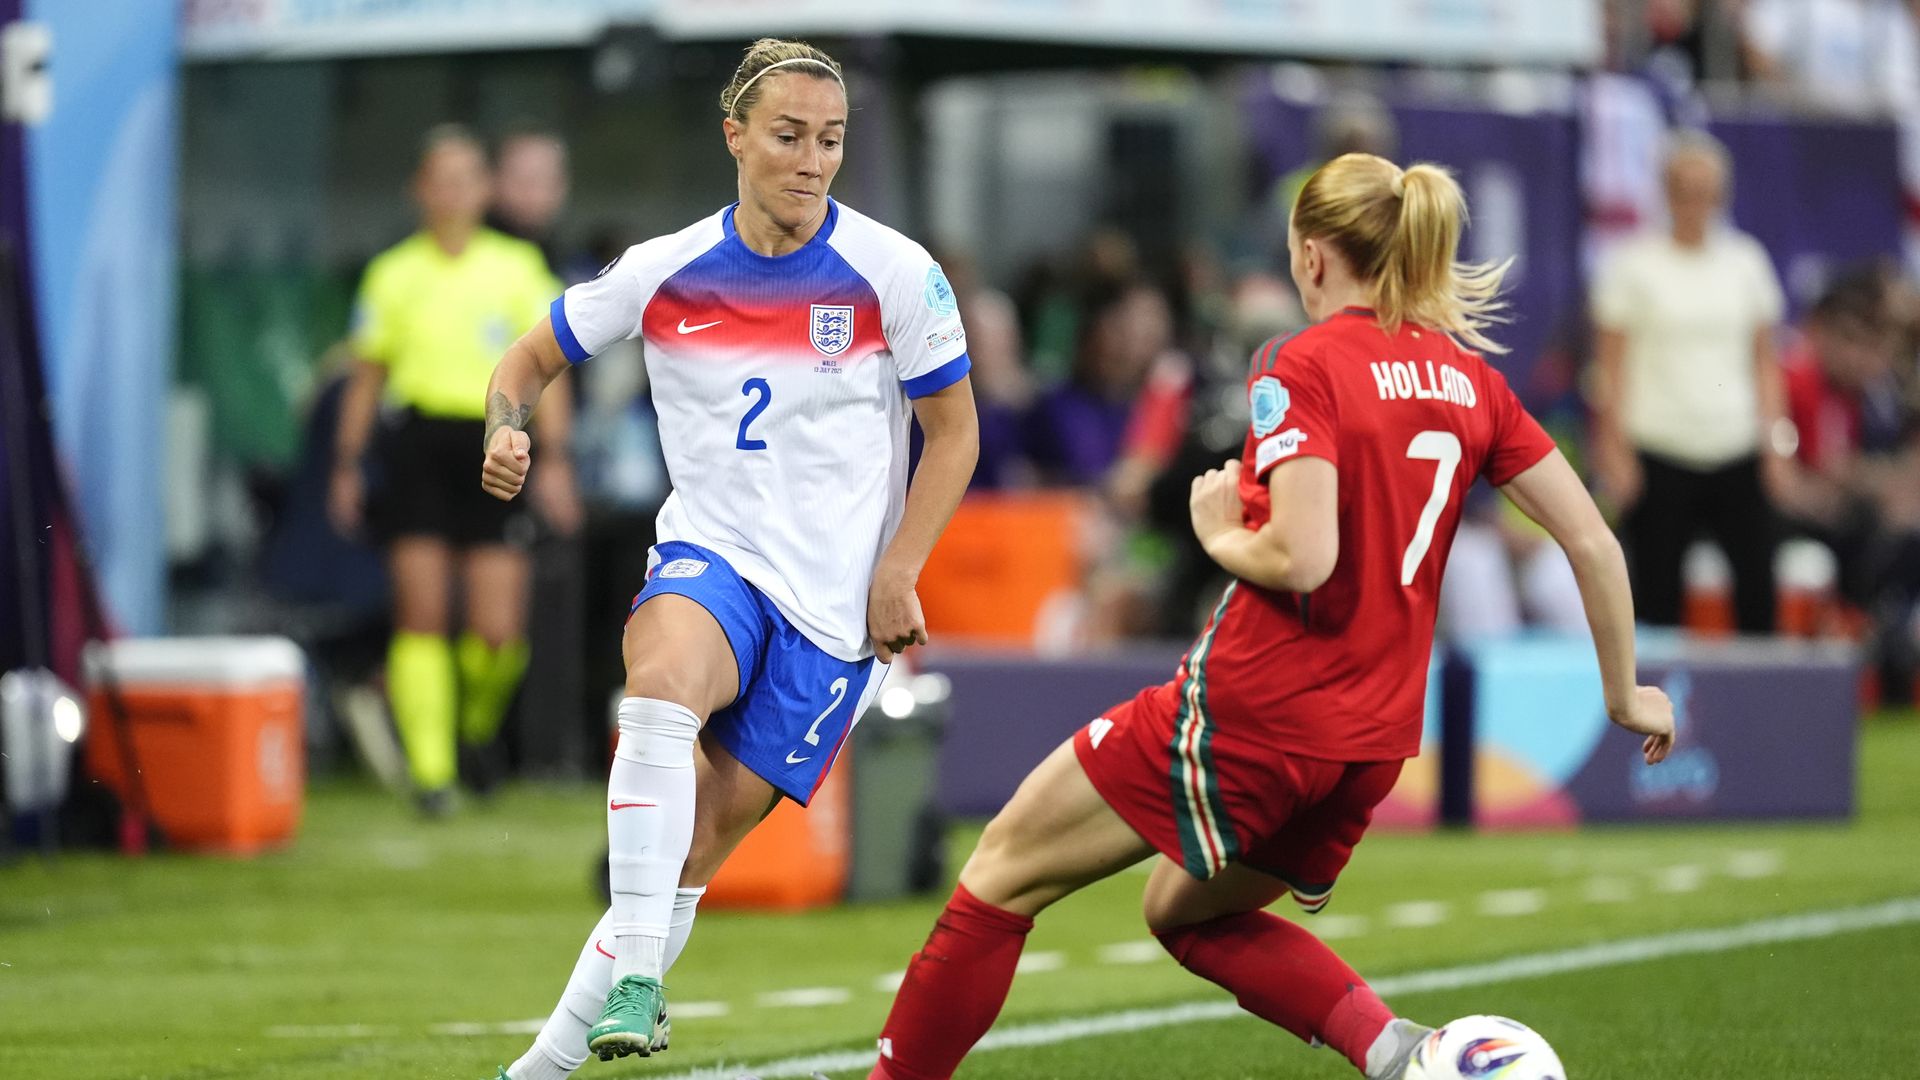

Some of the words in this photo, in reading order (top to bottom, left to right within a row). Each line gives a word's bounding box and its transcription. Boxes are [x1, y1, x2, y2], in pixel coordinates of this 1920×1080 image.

[736, 377, 772, 450] 2
[1370, 360, 1477, 409] HOLLAND
[1401, 430, 1462, 586] 7
[803, 677, 849, 747] 2
